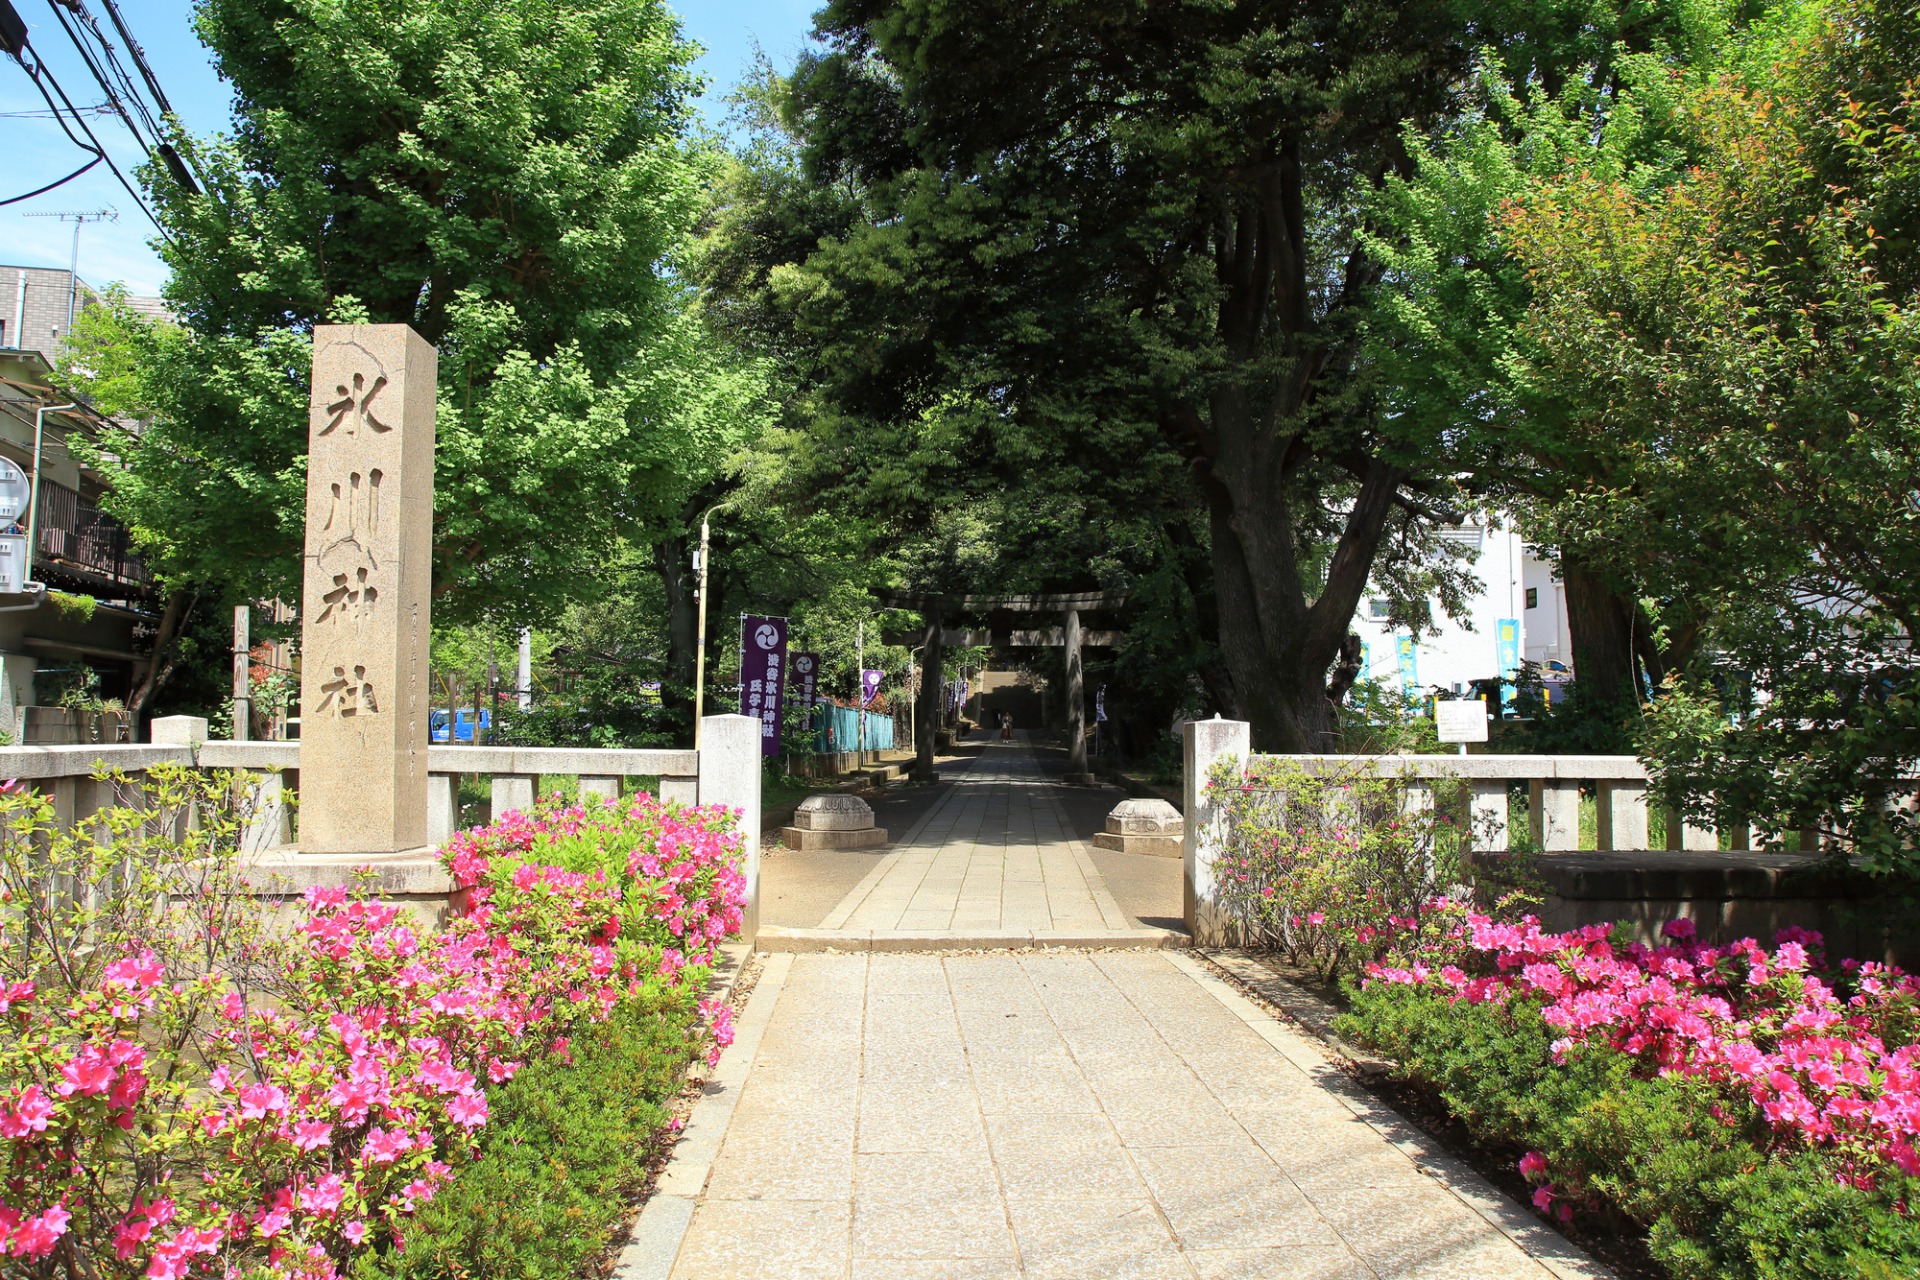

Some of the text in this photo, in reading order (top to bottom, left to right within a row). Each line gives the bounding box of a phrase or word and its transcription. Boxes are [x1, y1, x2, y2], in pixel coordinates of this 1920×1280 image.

[316, 372, 393, 720] 氷川神社
[762, 653, 779, 737] 渋谷氷川神社
